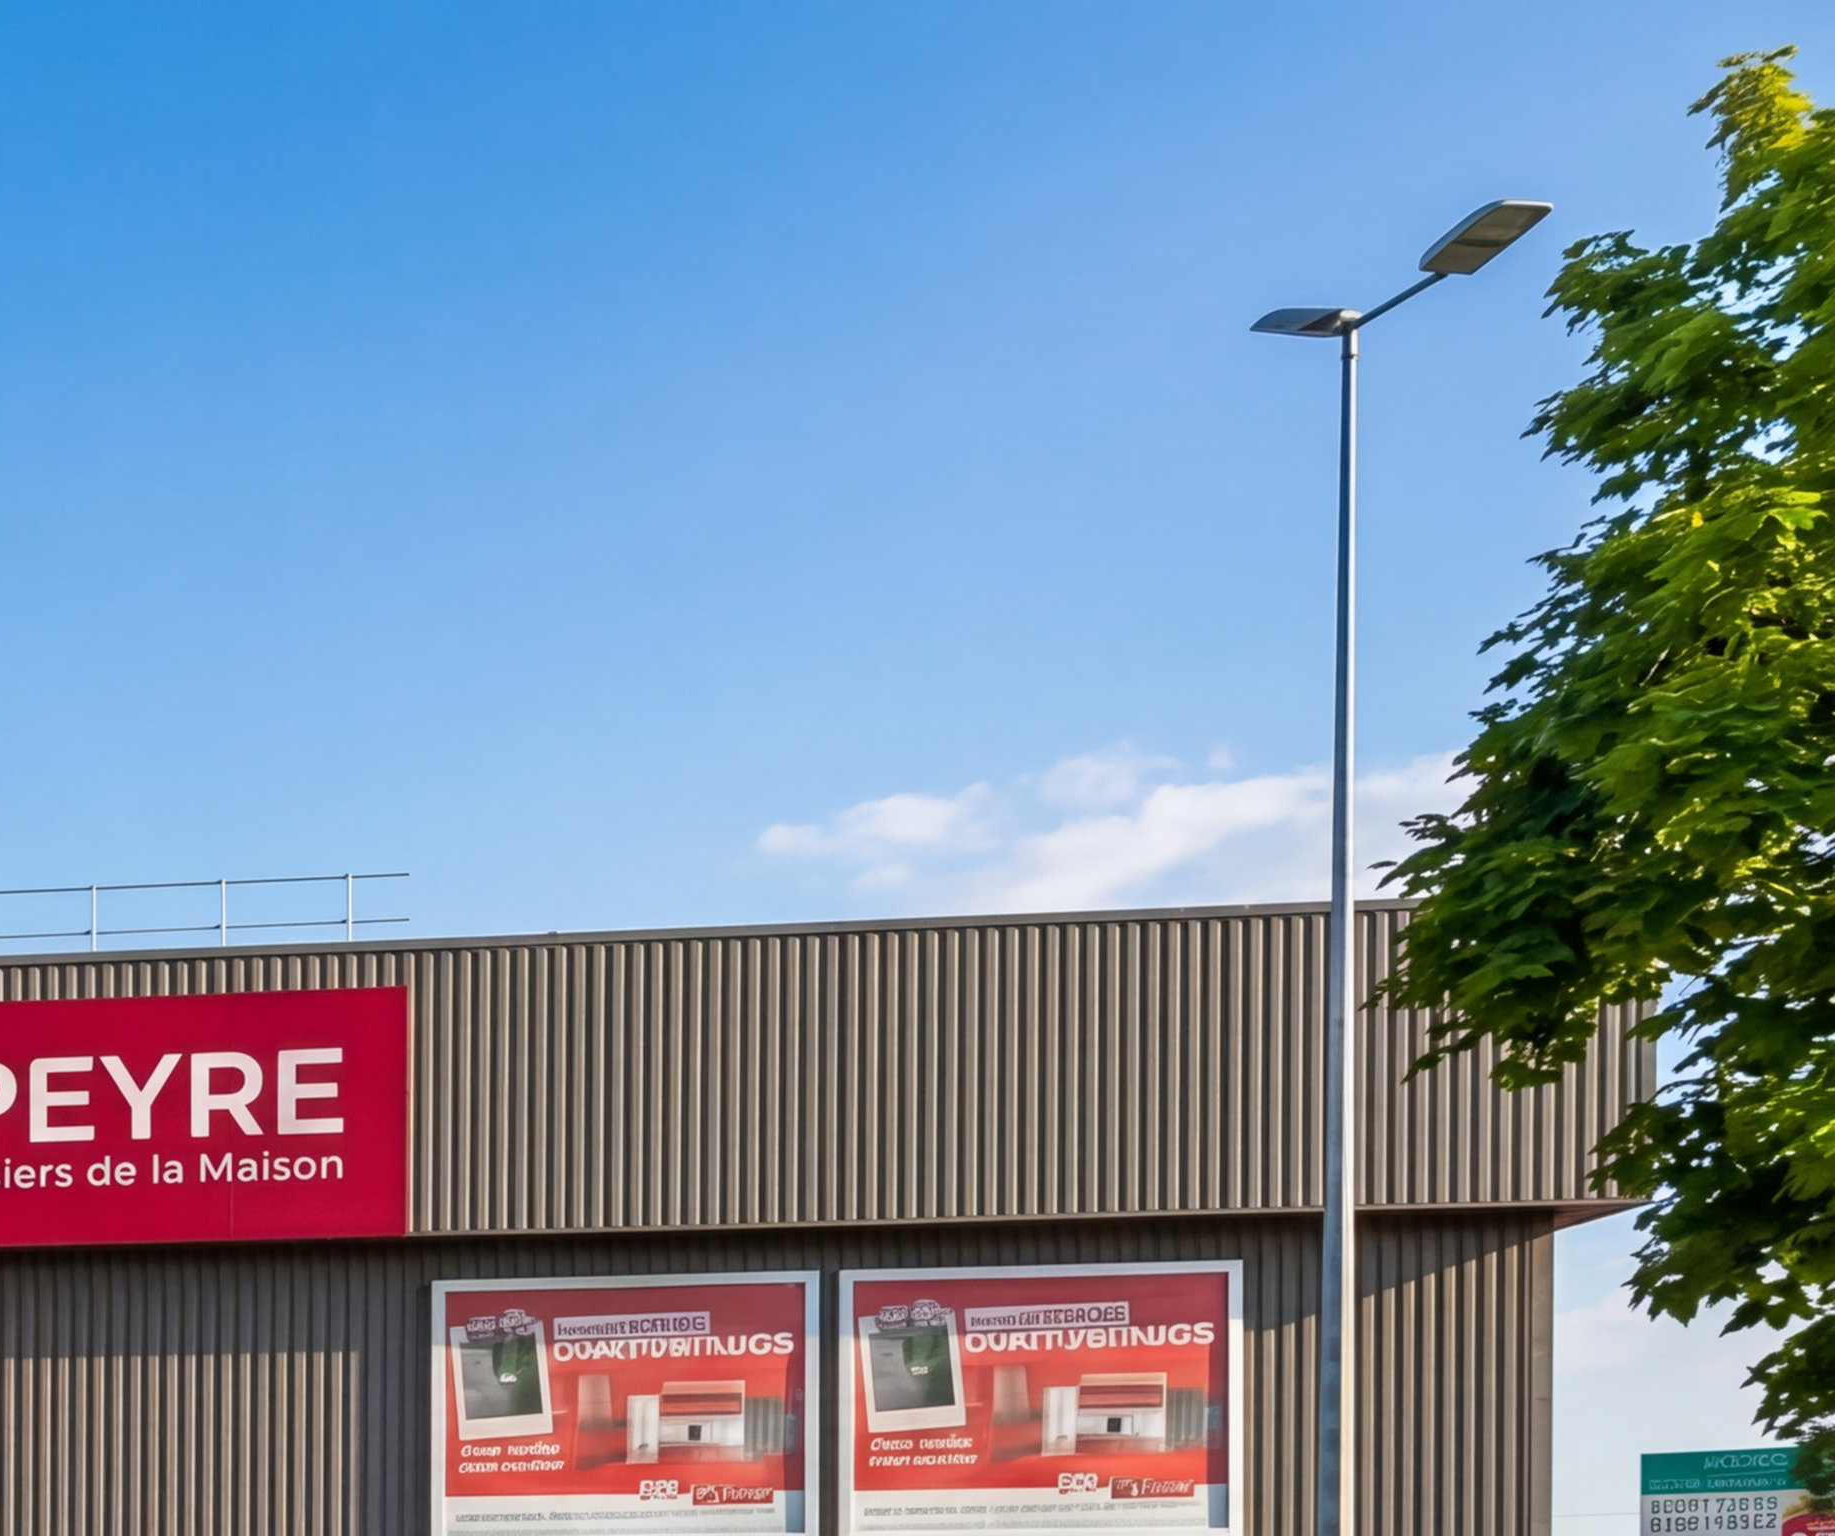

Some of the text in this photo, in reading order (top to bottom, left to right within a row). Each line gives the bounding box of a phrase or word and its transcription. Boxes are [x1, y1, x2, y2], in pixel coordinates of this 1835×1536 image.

[86, 1155, 137, 1187] de
[152, 1153, 184, 1184] la
[199, 1150, 344, 1184] Maison
